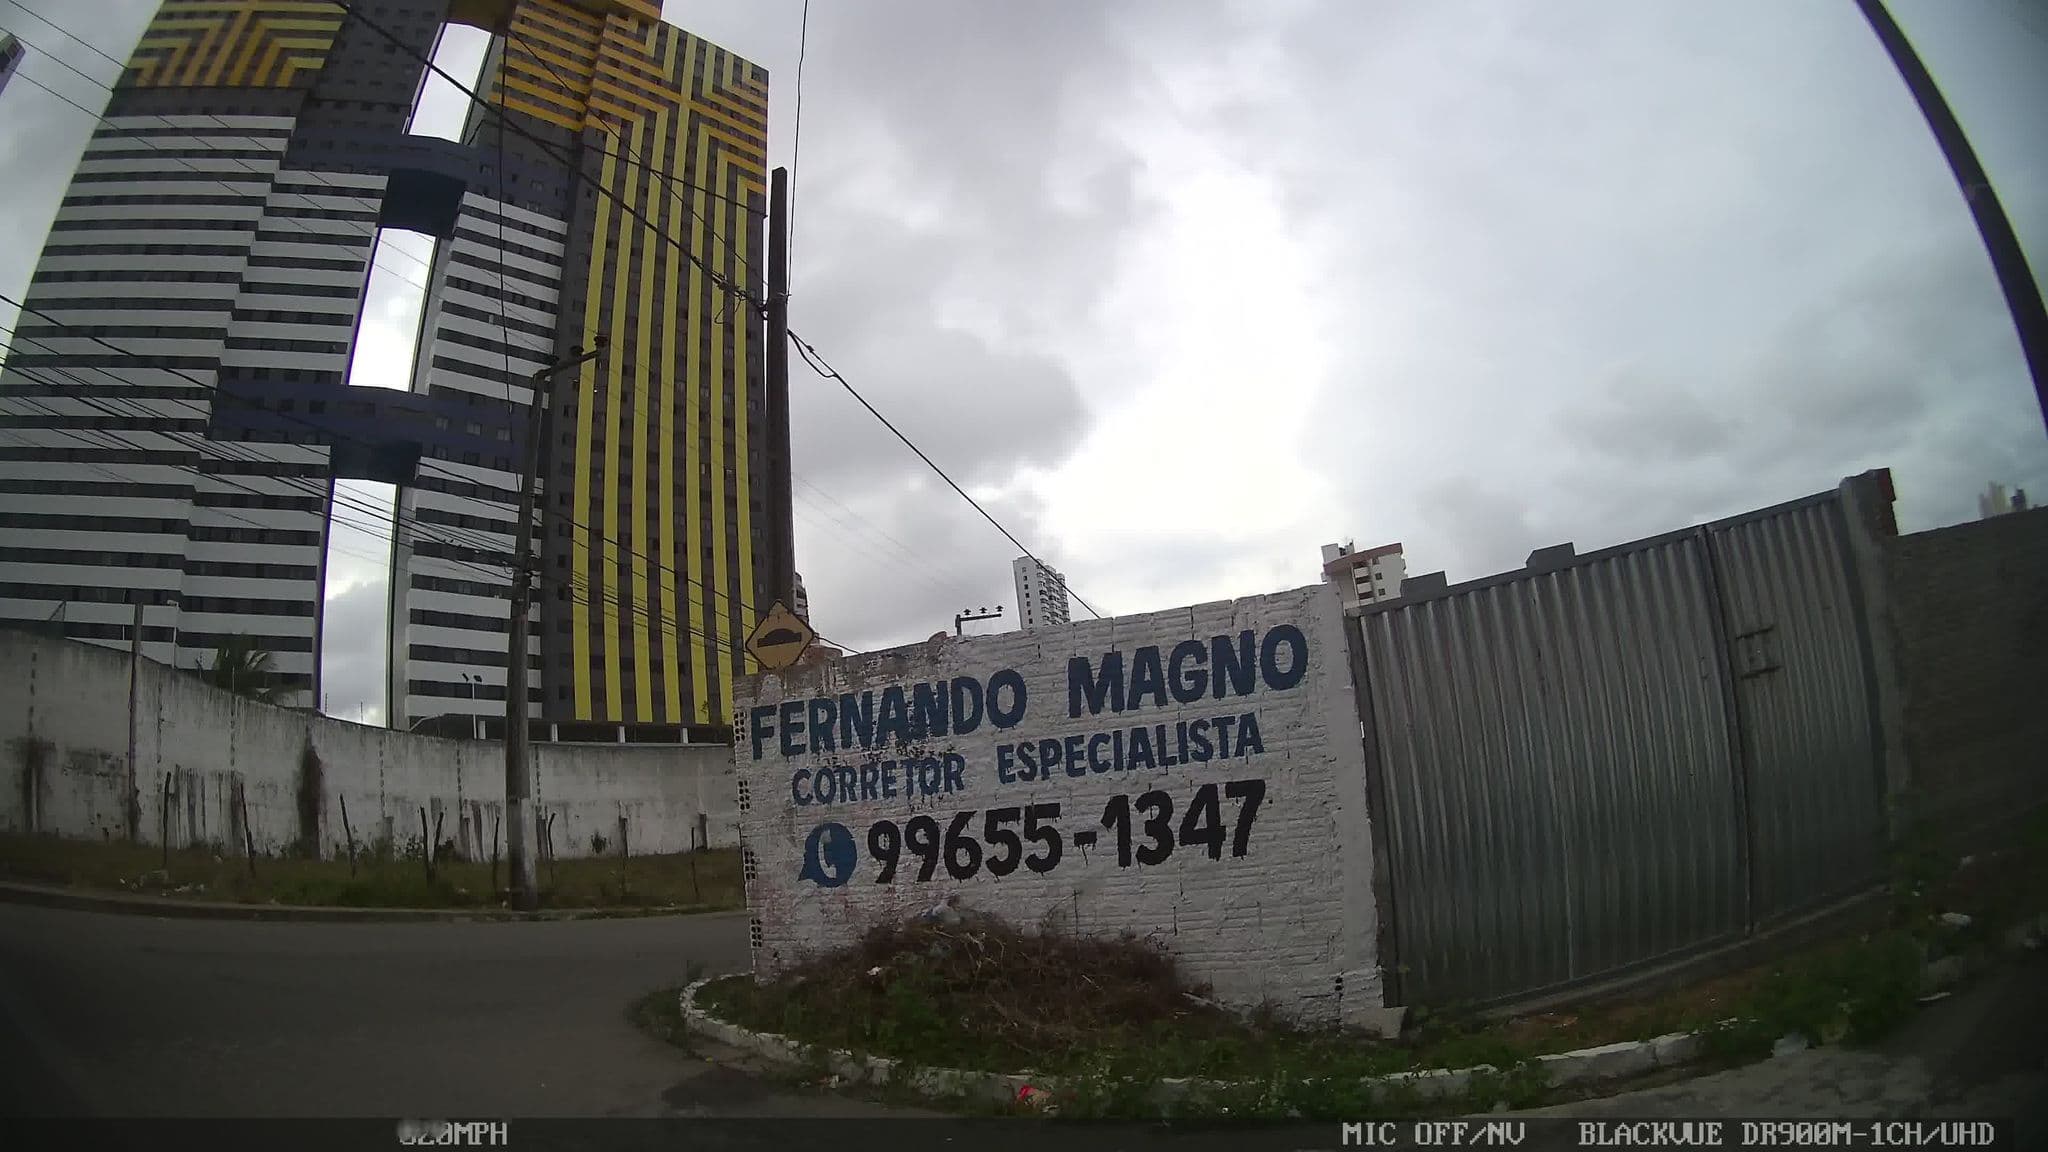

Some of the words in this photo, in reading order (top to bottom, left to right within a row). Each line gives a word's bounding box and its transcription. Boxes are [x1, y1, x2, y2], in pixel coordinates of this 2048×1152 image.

[751, 669, 1027, 760] FERNANDO
[1068, 624, 1308, 718] MAGNO
[792, 753, 965, 805] CORRETOR
[996, 712, 1264, 784] ESPECIALISTA
[868, 779, 1266, 883] 99655-1347
